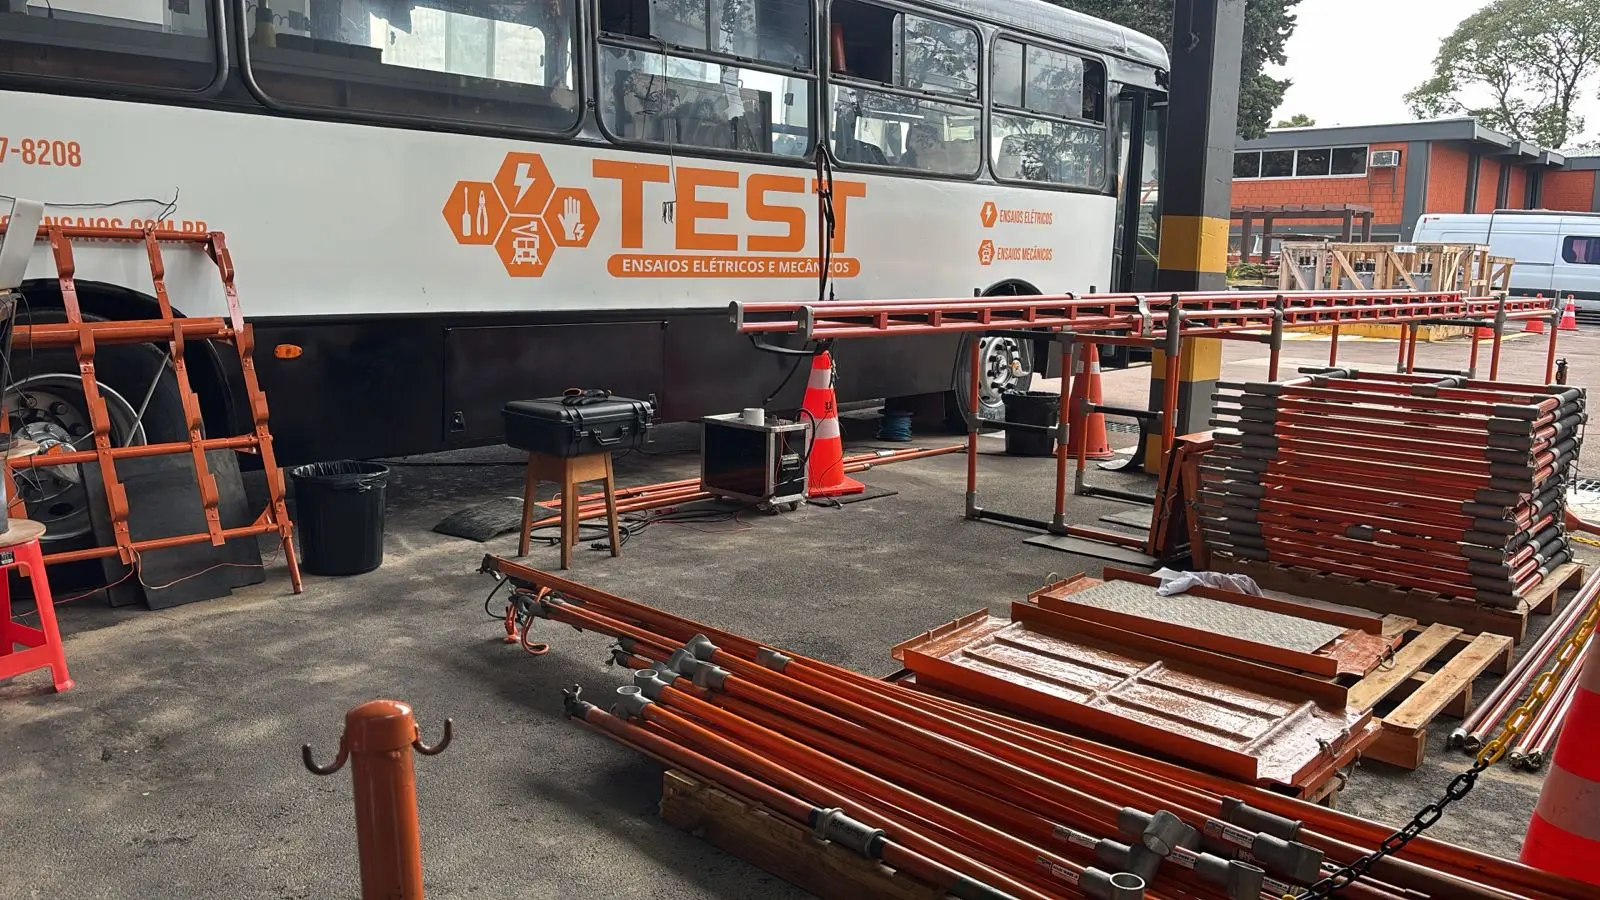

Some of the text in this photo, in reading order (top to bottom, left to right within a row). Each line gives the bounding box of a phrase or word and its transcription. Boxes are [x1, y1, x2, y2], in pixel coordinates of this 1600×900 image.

[0, 137, 82, 167] 7-8208
[592, 159, 866, 253] TEST
[622, 258, 689, 273] ENSAIOS
[693, 257, 766, 274] ELÉTRICOS
[768, 261, 776, 273] E
